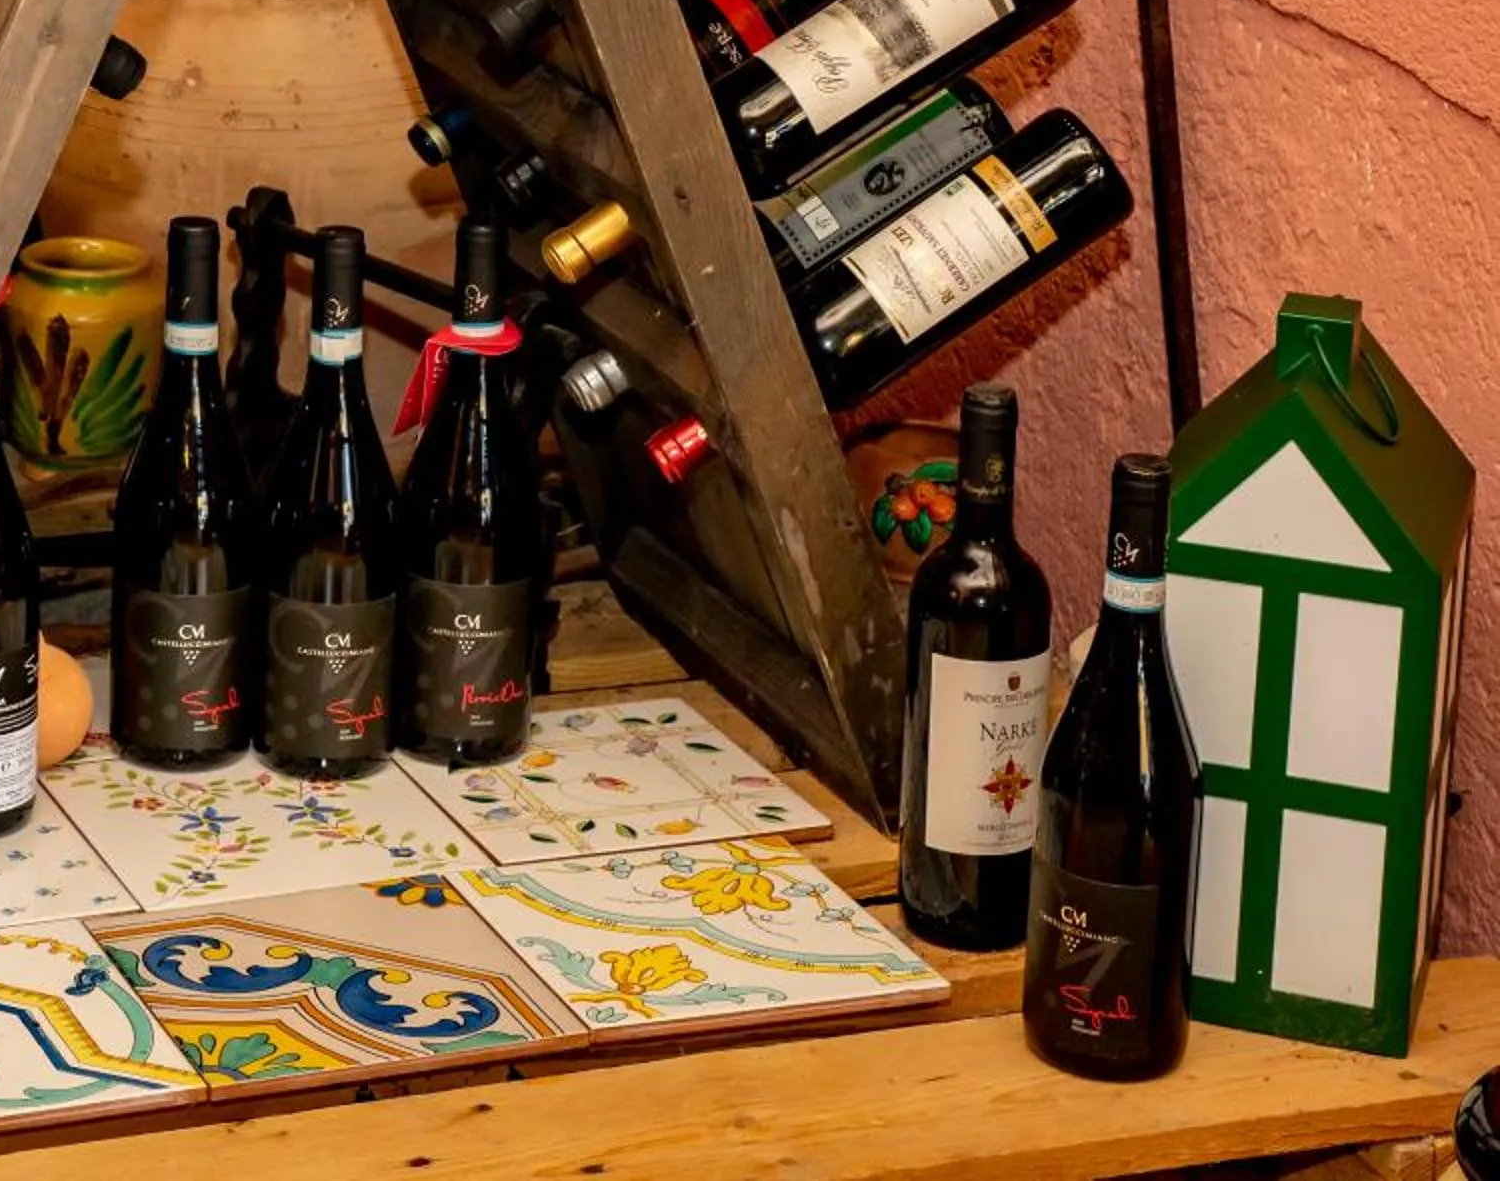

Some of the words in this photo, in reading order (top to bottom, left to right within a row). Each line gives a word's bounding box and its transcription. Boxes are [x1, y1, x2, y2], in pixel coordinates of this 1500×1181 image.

[454, 614, 481, 629] CM
[178, 625, 205, 639] CM
[325, 633, 351, 648] CM
[1061, 906, 1087, 927] CM
